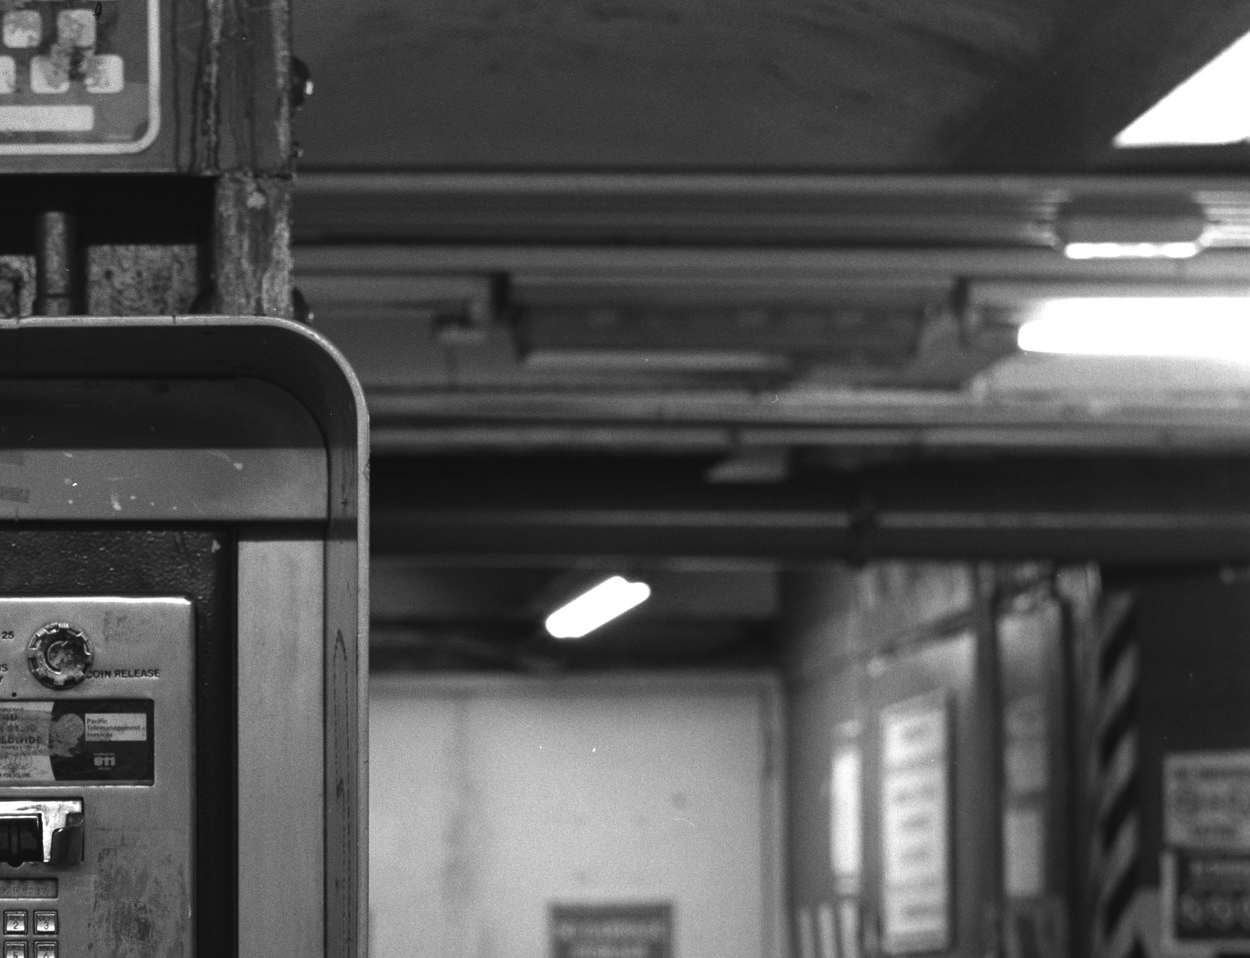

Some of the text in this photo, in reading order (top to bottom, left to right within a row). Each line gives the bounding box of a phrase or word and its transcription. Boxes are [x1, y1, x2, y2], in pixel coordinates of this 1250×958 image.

[114, 668, 161, 679] RELEASE
[13, 920, 19, 930] 2
[43, 920, 49, 930] 3
